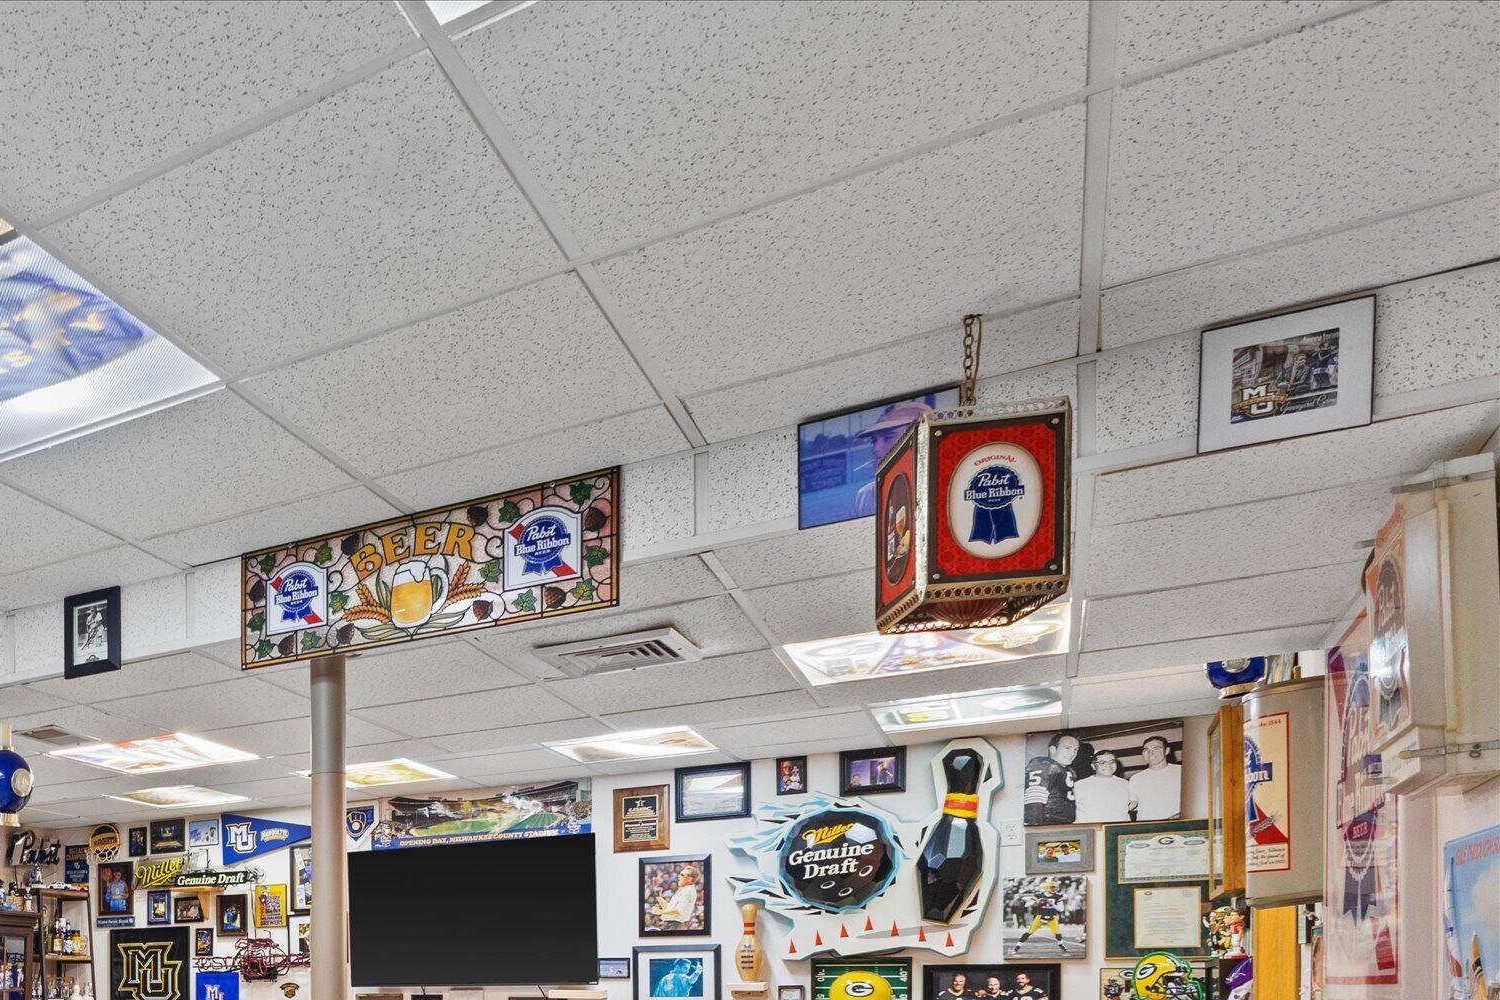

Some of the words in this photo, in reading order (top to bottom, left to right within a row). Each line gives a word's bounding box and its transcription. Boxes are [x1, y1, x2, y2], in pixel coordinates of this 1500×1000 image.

[974, 454, 1017, 466] ORIGINAL
[977, 472, 1011, 487] Pabst
[965, 490, 988, 500] Blue
[988, 487, 1025, 498] Ribbon
[526, 523, 558, 543] Pabst
[350, 521, 476, 582] BEER
[514, 541, 536, 557] Blue
[535, 536, 571, 552] Ribbon
[284, 577, 309, 592] Pabst
[274, 592, 291, 605] Blue
[291, 587, 319, 602] Ribbon
[225, 822, 257, 853] MU
[399, 838, 432, 846] OPENING
[450, 834, 493, 844] MILWAUKEE
[493, 832, 523, 840] COUNTY
[802, 823, 854, 846] Miller
[789, 842, 874, 866] Genuine
[135, 857, 184, 888] Miller
[177, 874, 216, 886] Genuine
[218, 872, 245, 884] Draft
[802, 858, 860, 880] Draft
